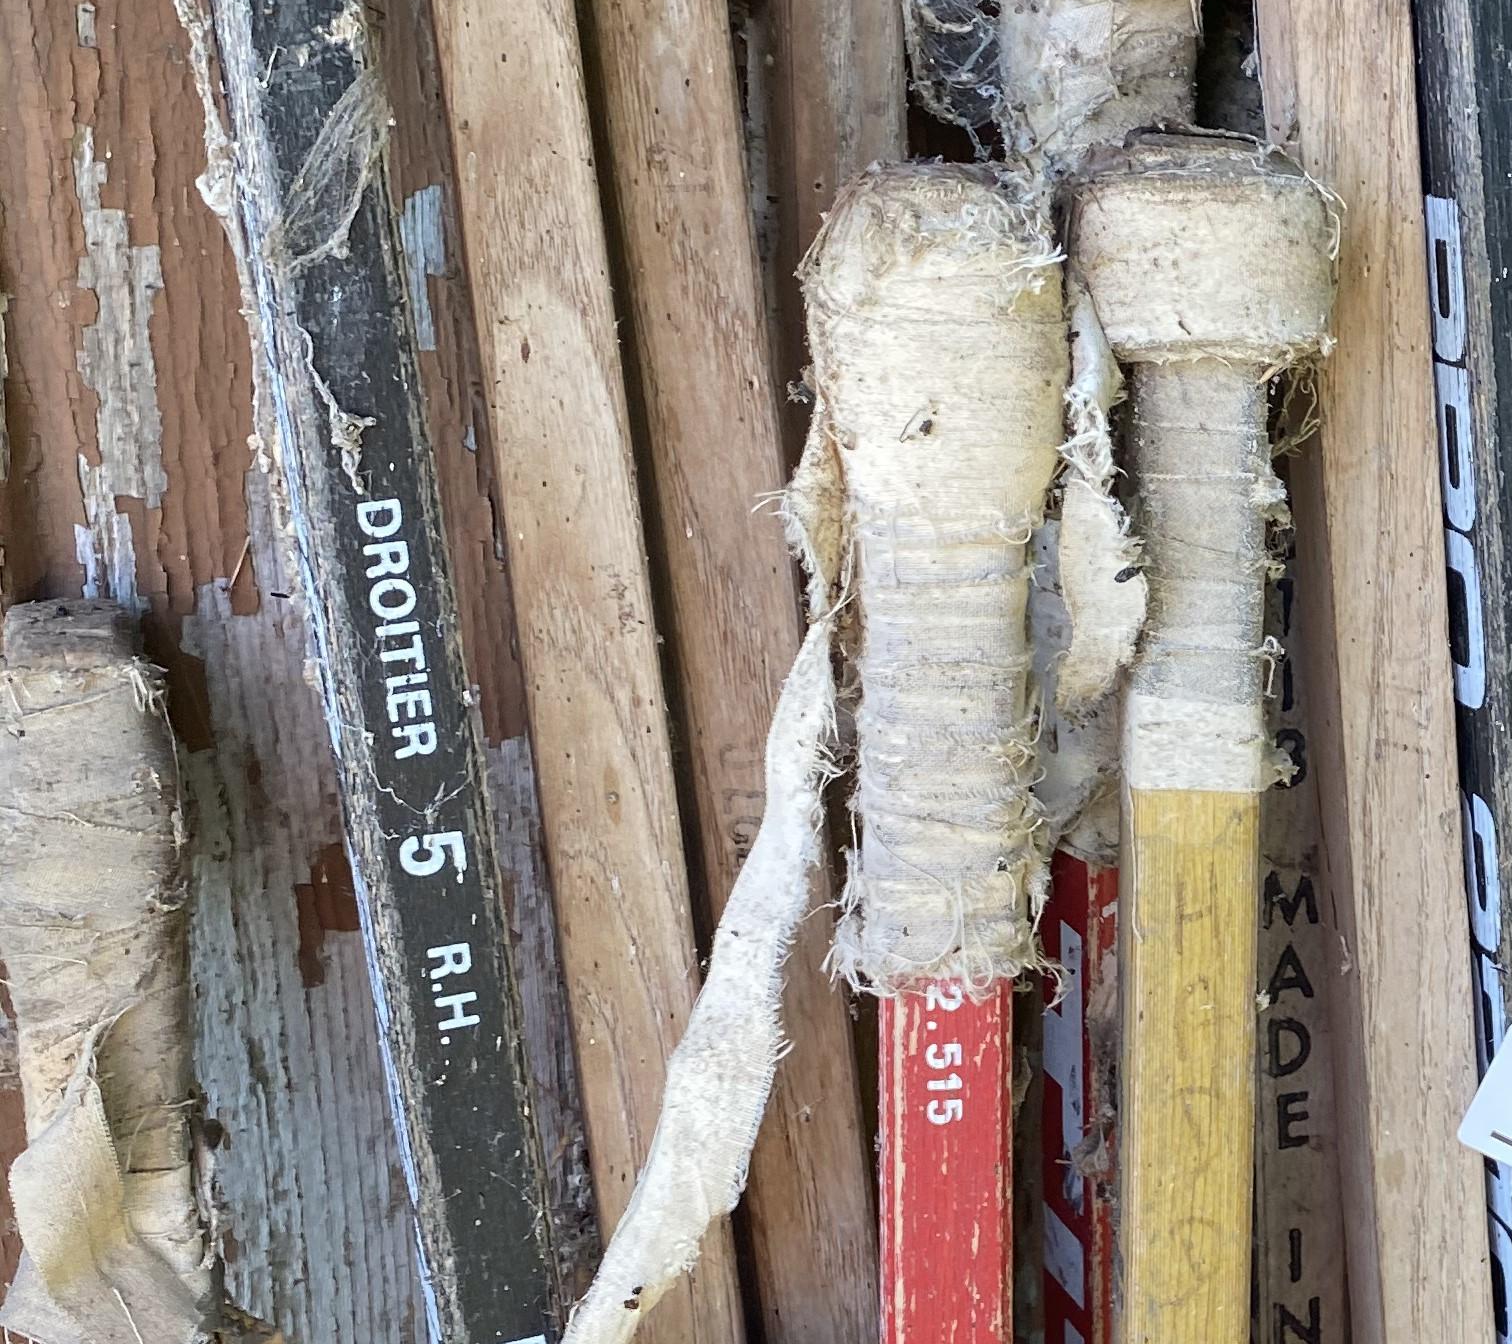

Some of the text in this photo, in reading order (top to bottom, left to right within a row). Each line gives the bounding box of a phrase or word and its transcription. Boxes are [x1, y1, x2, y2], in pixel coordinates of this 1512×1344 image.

[355, 497, 481, 1046] DROITIER 5 R.H.
[1261, 870, 1321, 1151] MADE
